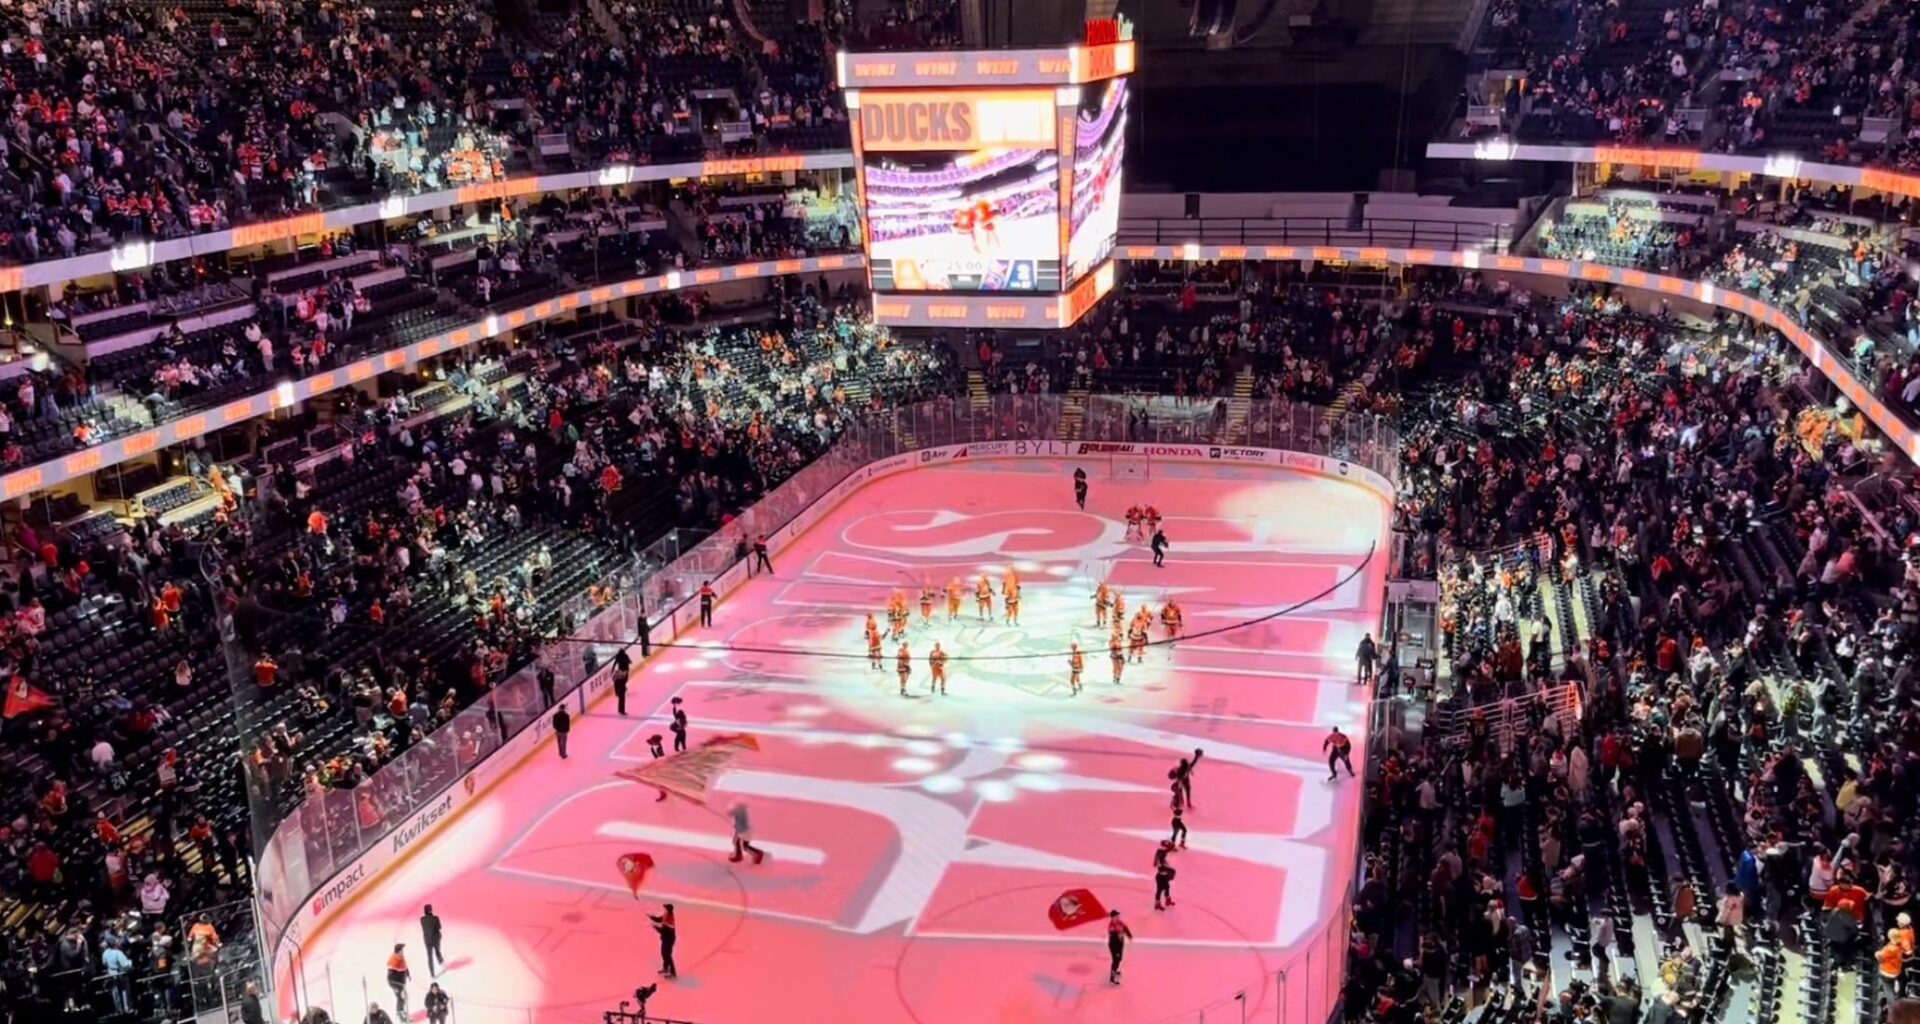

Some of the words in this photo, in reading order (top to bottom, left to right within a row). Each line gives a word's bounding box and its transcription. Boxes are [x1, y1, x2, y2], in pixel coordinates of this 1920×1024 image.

[855, 63, 896, 76] WIN!
[915, 61, 957, 76] WIN!
[976, 60, 1018, 75] WIN!
[864, 102, 972, 142] DUCKS
[1015, 441, 1073, 455] BYLT
[1144, 446, 1203, 457] HONDA
[1223, 448, 1266, 458] VICTORY
[393, 795, 453, 853] Kwikset
[320, 863, 366, 909] impact
